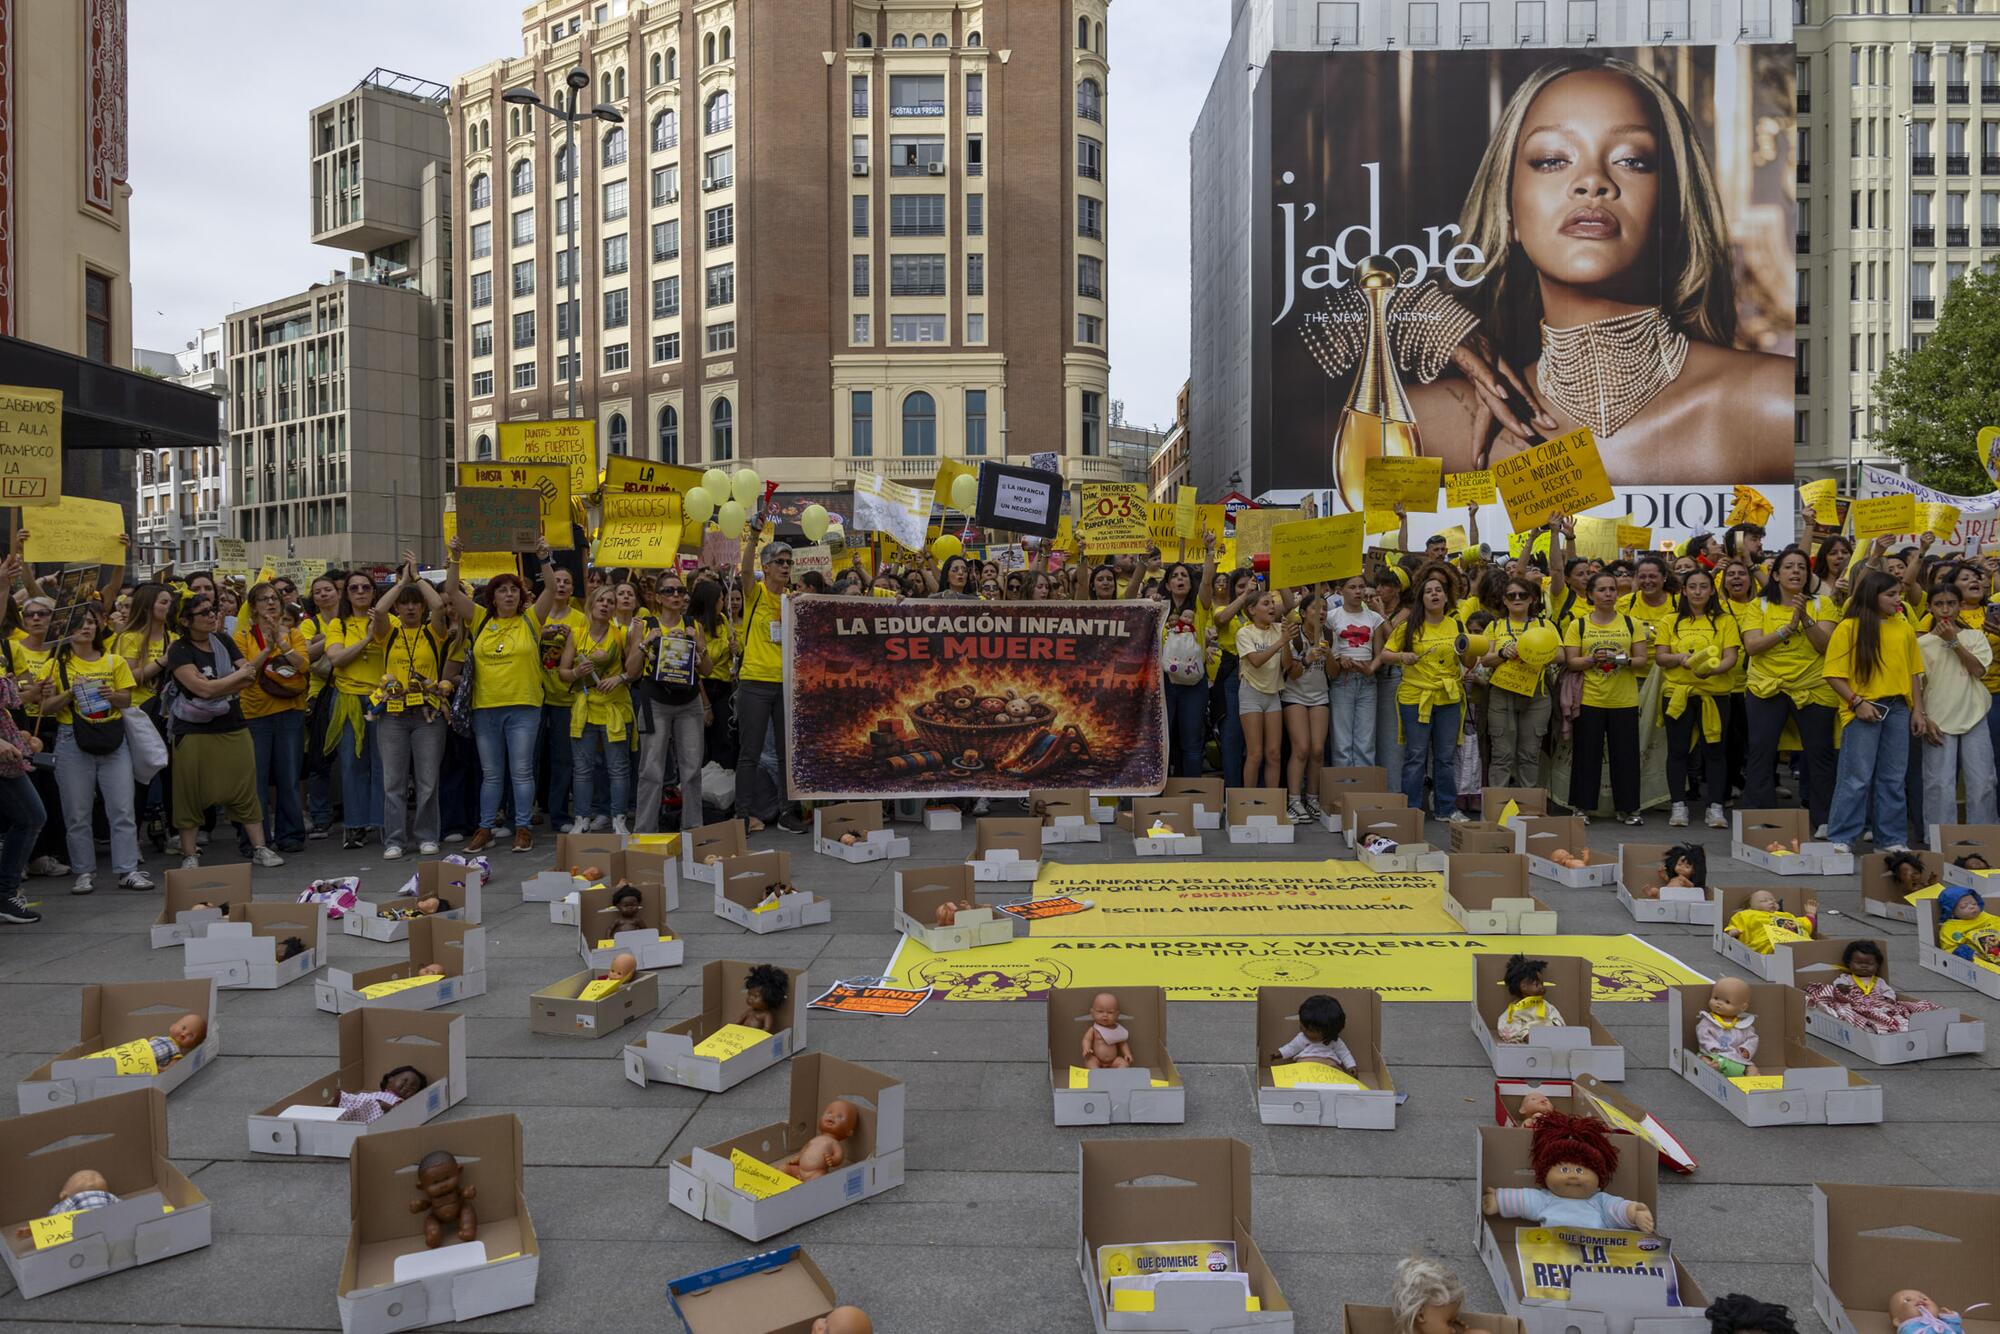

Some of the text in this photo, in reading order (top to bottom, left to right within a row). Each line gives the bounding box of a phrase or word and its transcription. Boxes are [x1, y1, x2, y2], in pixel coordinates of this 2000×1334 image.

[891, 107, 913, 115] OSTAL
[1304, 312, 1329, 322] THE
[1333, 311, 1364, 322] NEW
[18, 421, 49, 437] AULA
[555, 425, 580, 437] SOMOS
[1496, 431, 1588, 478] QUIEN CUIDA DE
[5, 462, 20, 475] LA
[639, 466, 655, 482] LA
[1512, 455, 1575, 486] LA INFANCIA
[8, 480, 38, 496] LEY
[1099, 484, 1137, 493] INFORMES
[1541, 468, 1583, 495] RESPETO
[1096, 495, 1132, 518] 0-3
[1224, 502, 1248, 511] Metro
[1523, 486, 1580, 516] CONDICIONES
[1562, 493, 1598, 514] DIGNAS
[603, 536, 662, 548] ESTAMOS EN
[617, 550, 643, 560] LUCHA
[835, 611, 1130, 638] LA EDUCACIÓN INFANTIL
[885, 636, 1077, 661] SE MUERE
[1055, 886, 1102, 894] ¿POR
[1106, 884, 1144, 893] QUÉ
[1275, 883, 1299, 891] EN
[1303, 882, 1438, 891] PRECARIEDAD?
[1069, 878, 1091, 886] LA
[1096, 878, 1179, 886] INFANCIA
[1188, 905, 1273, 913] INFANTIL
[1050, 941, 1249, 950] ABANDONO
[1293, 940, 1488, 949] VIOLENCIA
[1153, 949, 1392, 957] INSTITUCIONAL
[831, 987, 928, 1001] SE VENDE
[45, 1230, 73, 1245] PAG
[1558, 1232, 1628, 1248] QUE COMIENCE
[1581, 1243, 1608, 1265] LA
[1136, 1254, 1199, 1269] QUE COMIENCE
[1210, 1263, 1226, 1272] CGT
